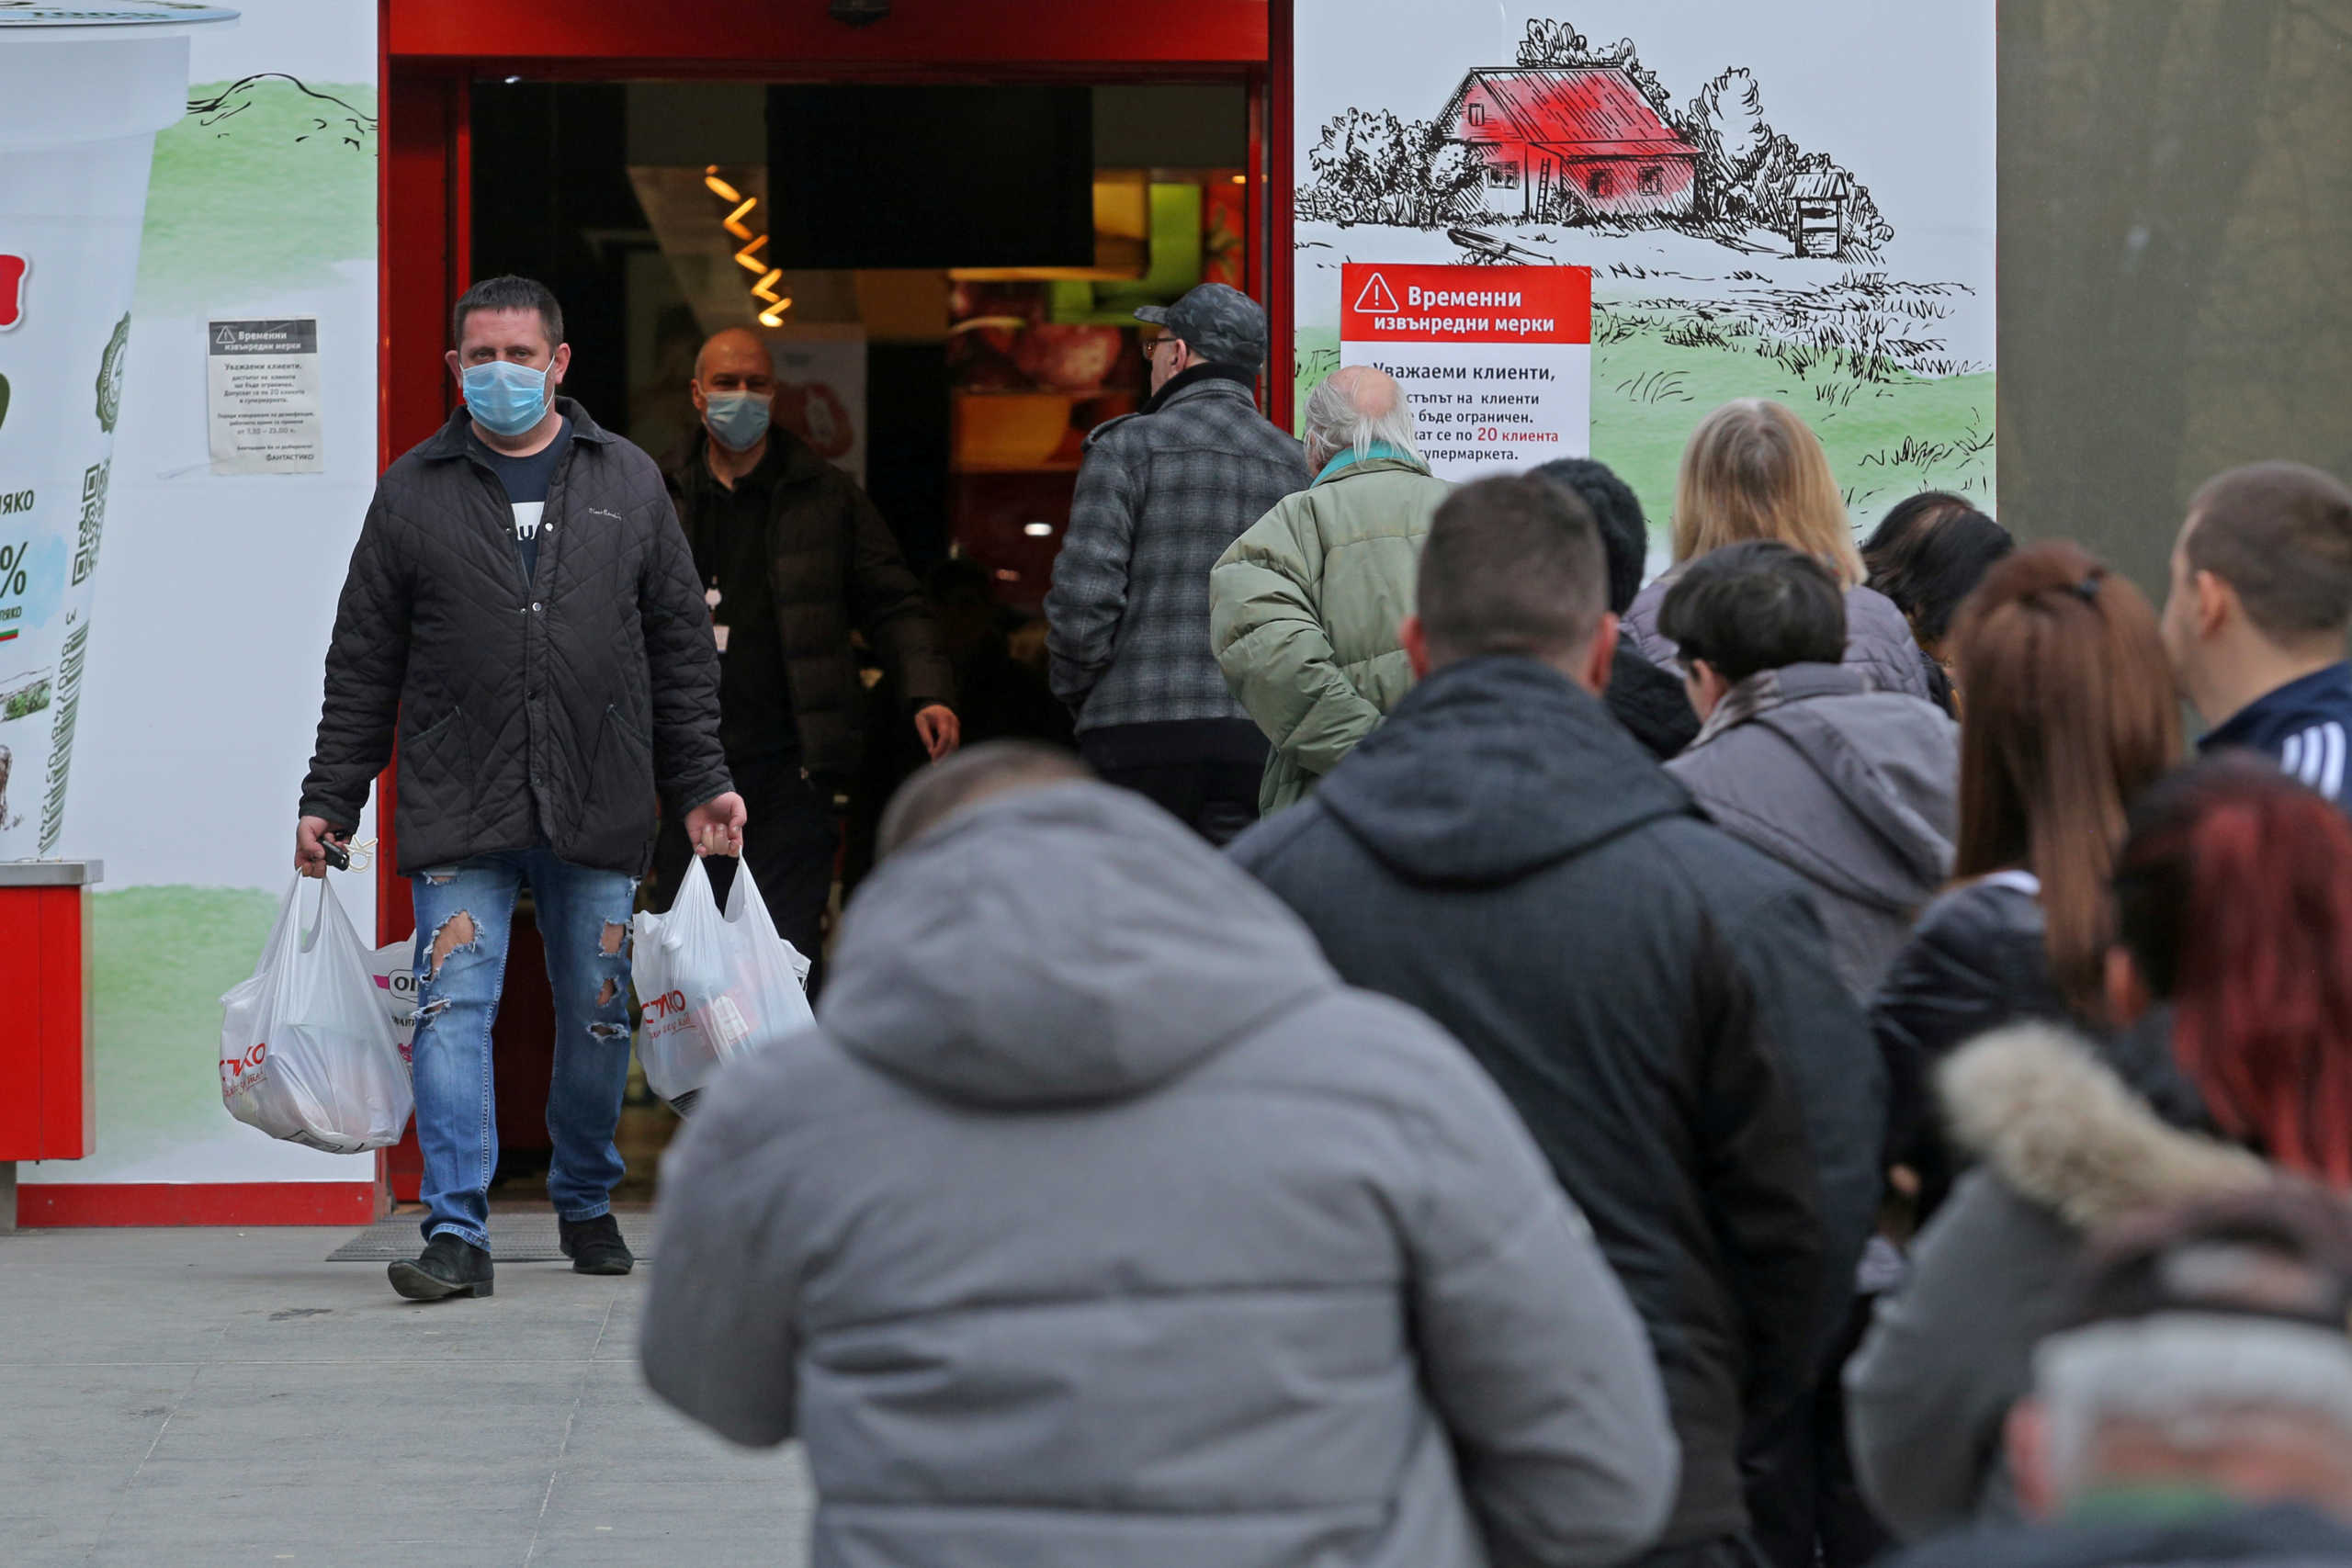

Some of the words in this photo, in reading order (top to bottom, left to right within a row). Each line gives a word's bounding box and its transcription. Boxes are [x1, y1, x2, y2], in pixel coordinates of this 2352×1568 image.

[1408, 286, 1521, 311] Временни
[1374, 315, 1489, 335] извънредни
[1495, 317, 1555, 336] мерки
[238, 331, 287, 342] Временни
[1473, 367, 1556, 381] клиенти,
[1407, 394, 1453, 405] стъпът
[1457, 395, 1473, 404] на
[1481, 395, 1540, 405] клиенти
[1419, 409, 1453, 424] бъде
[1456, 412, 1533, 425] ограничен.
[1437, 431, 1452, 441] се
[1456, 432, 1472, 441] по
[1477, 427, 1498, 442] 20
[1502, 432, 1559, 443] клиента
[0, 491, 35, 515] ЯКО
